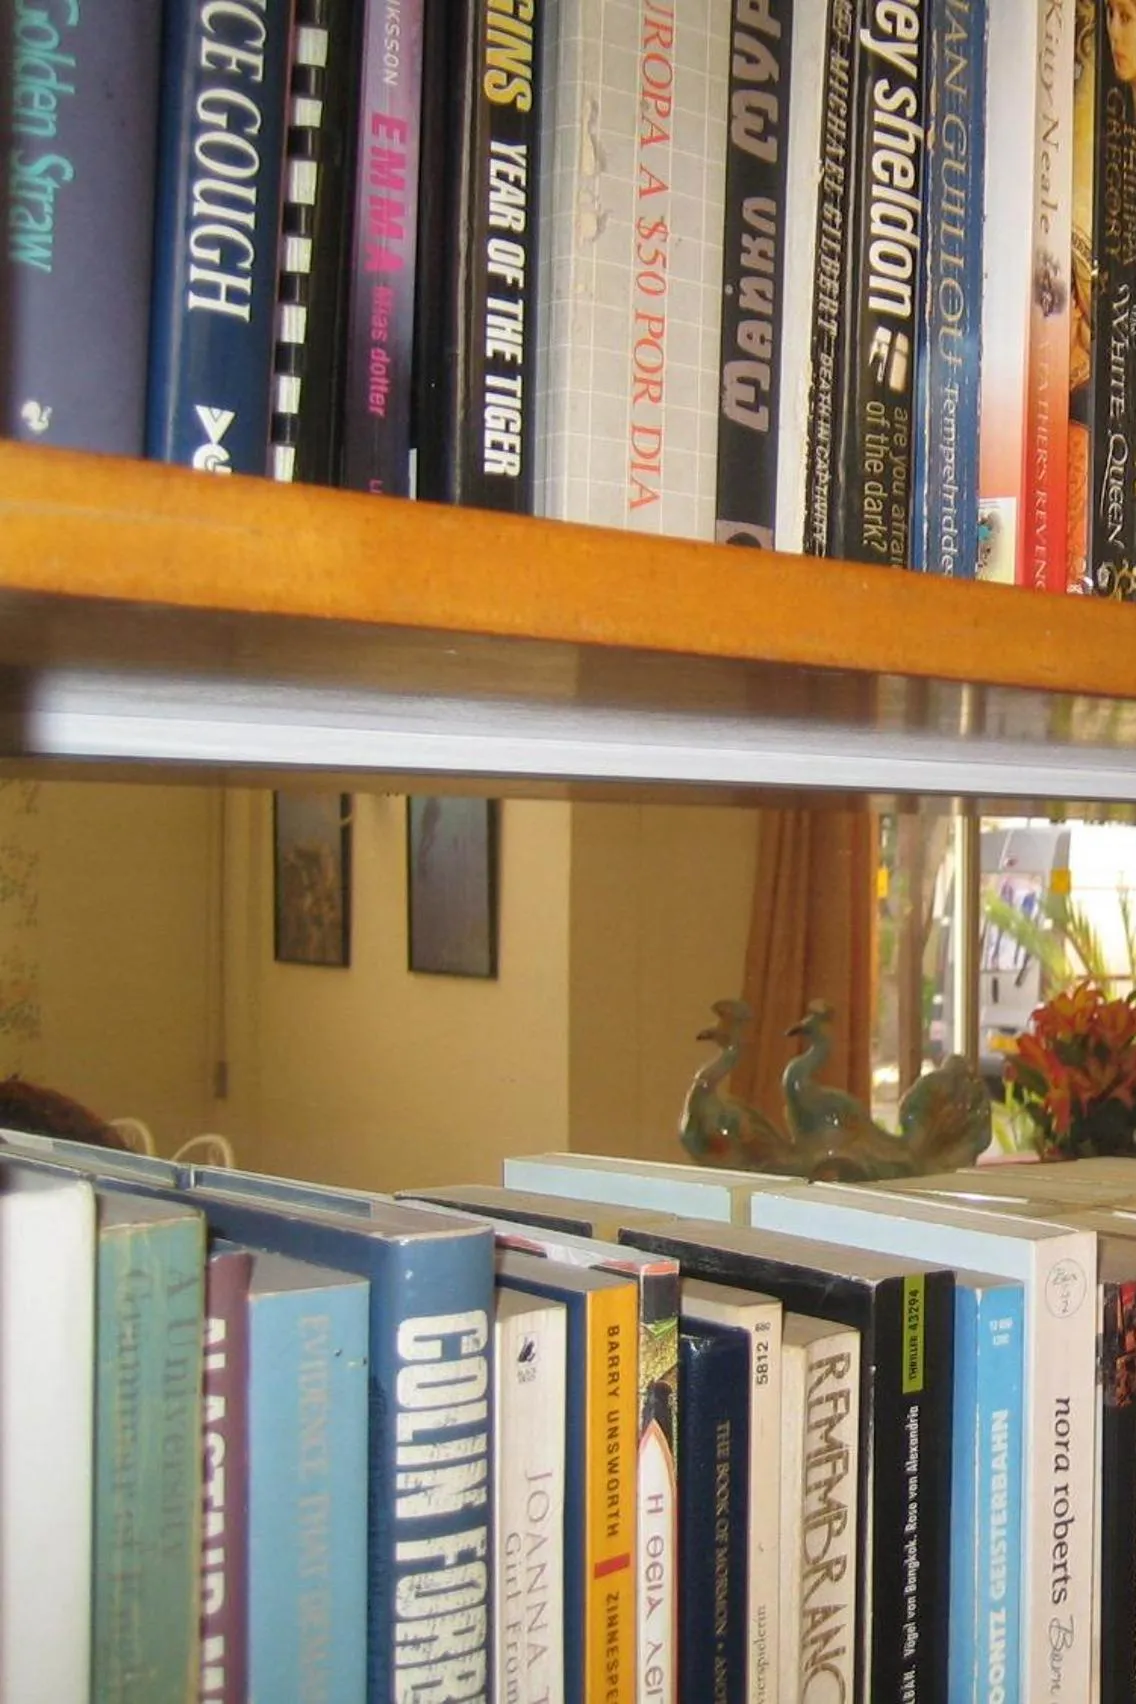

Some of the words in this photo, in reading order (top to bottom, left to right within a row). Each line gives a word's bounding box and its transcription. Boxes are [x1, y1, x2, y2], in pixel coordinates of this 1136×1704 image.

[199, 0, 268, 83] CE
[860, 0, 920, 81] ey
[1036, 0, 1063, 97] Kitty
[8, 152, 74, 273] Straw
[187, 87, 262, 323] GOUGH
[363, 111, 409, 273] EMMA
[487, 143, 529, 228] YEAR
[638, 163, 669, 199] A
[866, 78, 923, 318] sheldon
[1038, 113, 1061, 236] Neale
[1104, 88, 1126, 263] GREGORY
[486, 236, 525, 288] OF
[634, 215, 669, 298] $50
[815, 203, 844, 339] GILBERT
[937, 111, 969, 369] GUILLOU
[484, 295, 524, 366] THE
[632, 308, 666, 407] POR
[368, 345, 395, 418] dotter
[817, 353, 835, 414] DEATH
[866, 401, 892, 425] of
[482, 375, 523, 478] TIGER
[628, 424, 663, 512] DIA
[816, 418, 833, 440] IN
[863, 436, 891, 476] the
[892, 405, 909, 449] are
[809, 447, 832, 546] CAPTIVITY
[891, 455, 910, 491] you
[860, 481, 890, 553] dark?
[889, 503, 908, 571] afrai
[166, 1266, 200, 1300] A
[908, 1288, 920, 1332] 43294
[299, 1313, 331, 1479] EVIDENCE
[604, 1323, 621, 1408] BARRY
[755, 1340, 771, 1386] 5812
[908, 1334, 919, 1381] THRILLER
[395, 1309, 489, 1519] COLIN
[715, 1419, 733, 1460] THE
[905, 1405, 920, 1473] Alexandria
[1052, 1396, 1072, 1474] nora
[604, 1410, 622, 1539] UNSWORTH
[715, 1463, 732, 1518] BOOK
[905, 1475, 917, 1499] von
[988, 1409, 1010, 1601] GEISTERBAHN
[299, 1492, 332, 1580] THAT
[504, 1531, 523, 1600] Girl
[523, 1470, 553, 1674] JOANNA
[715, 1519, 731, 1545] OF
[903, 1533, 918, 1593] Bangkok.
[1050, 1484, 1076, 1605] roberts
[394, 1525, 489, 1704] FORB
[714, 1548, 730, 1636] MORMON
[904, 1596, 915, 1619] von
[503, 1618, 521, 1704] From
[602, 1591, 621, 1704] ZINNESPE
[903, 1622, 918, 1657] Vögel
